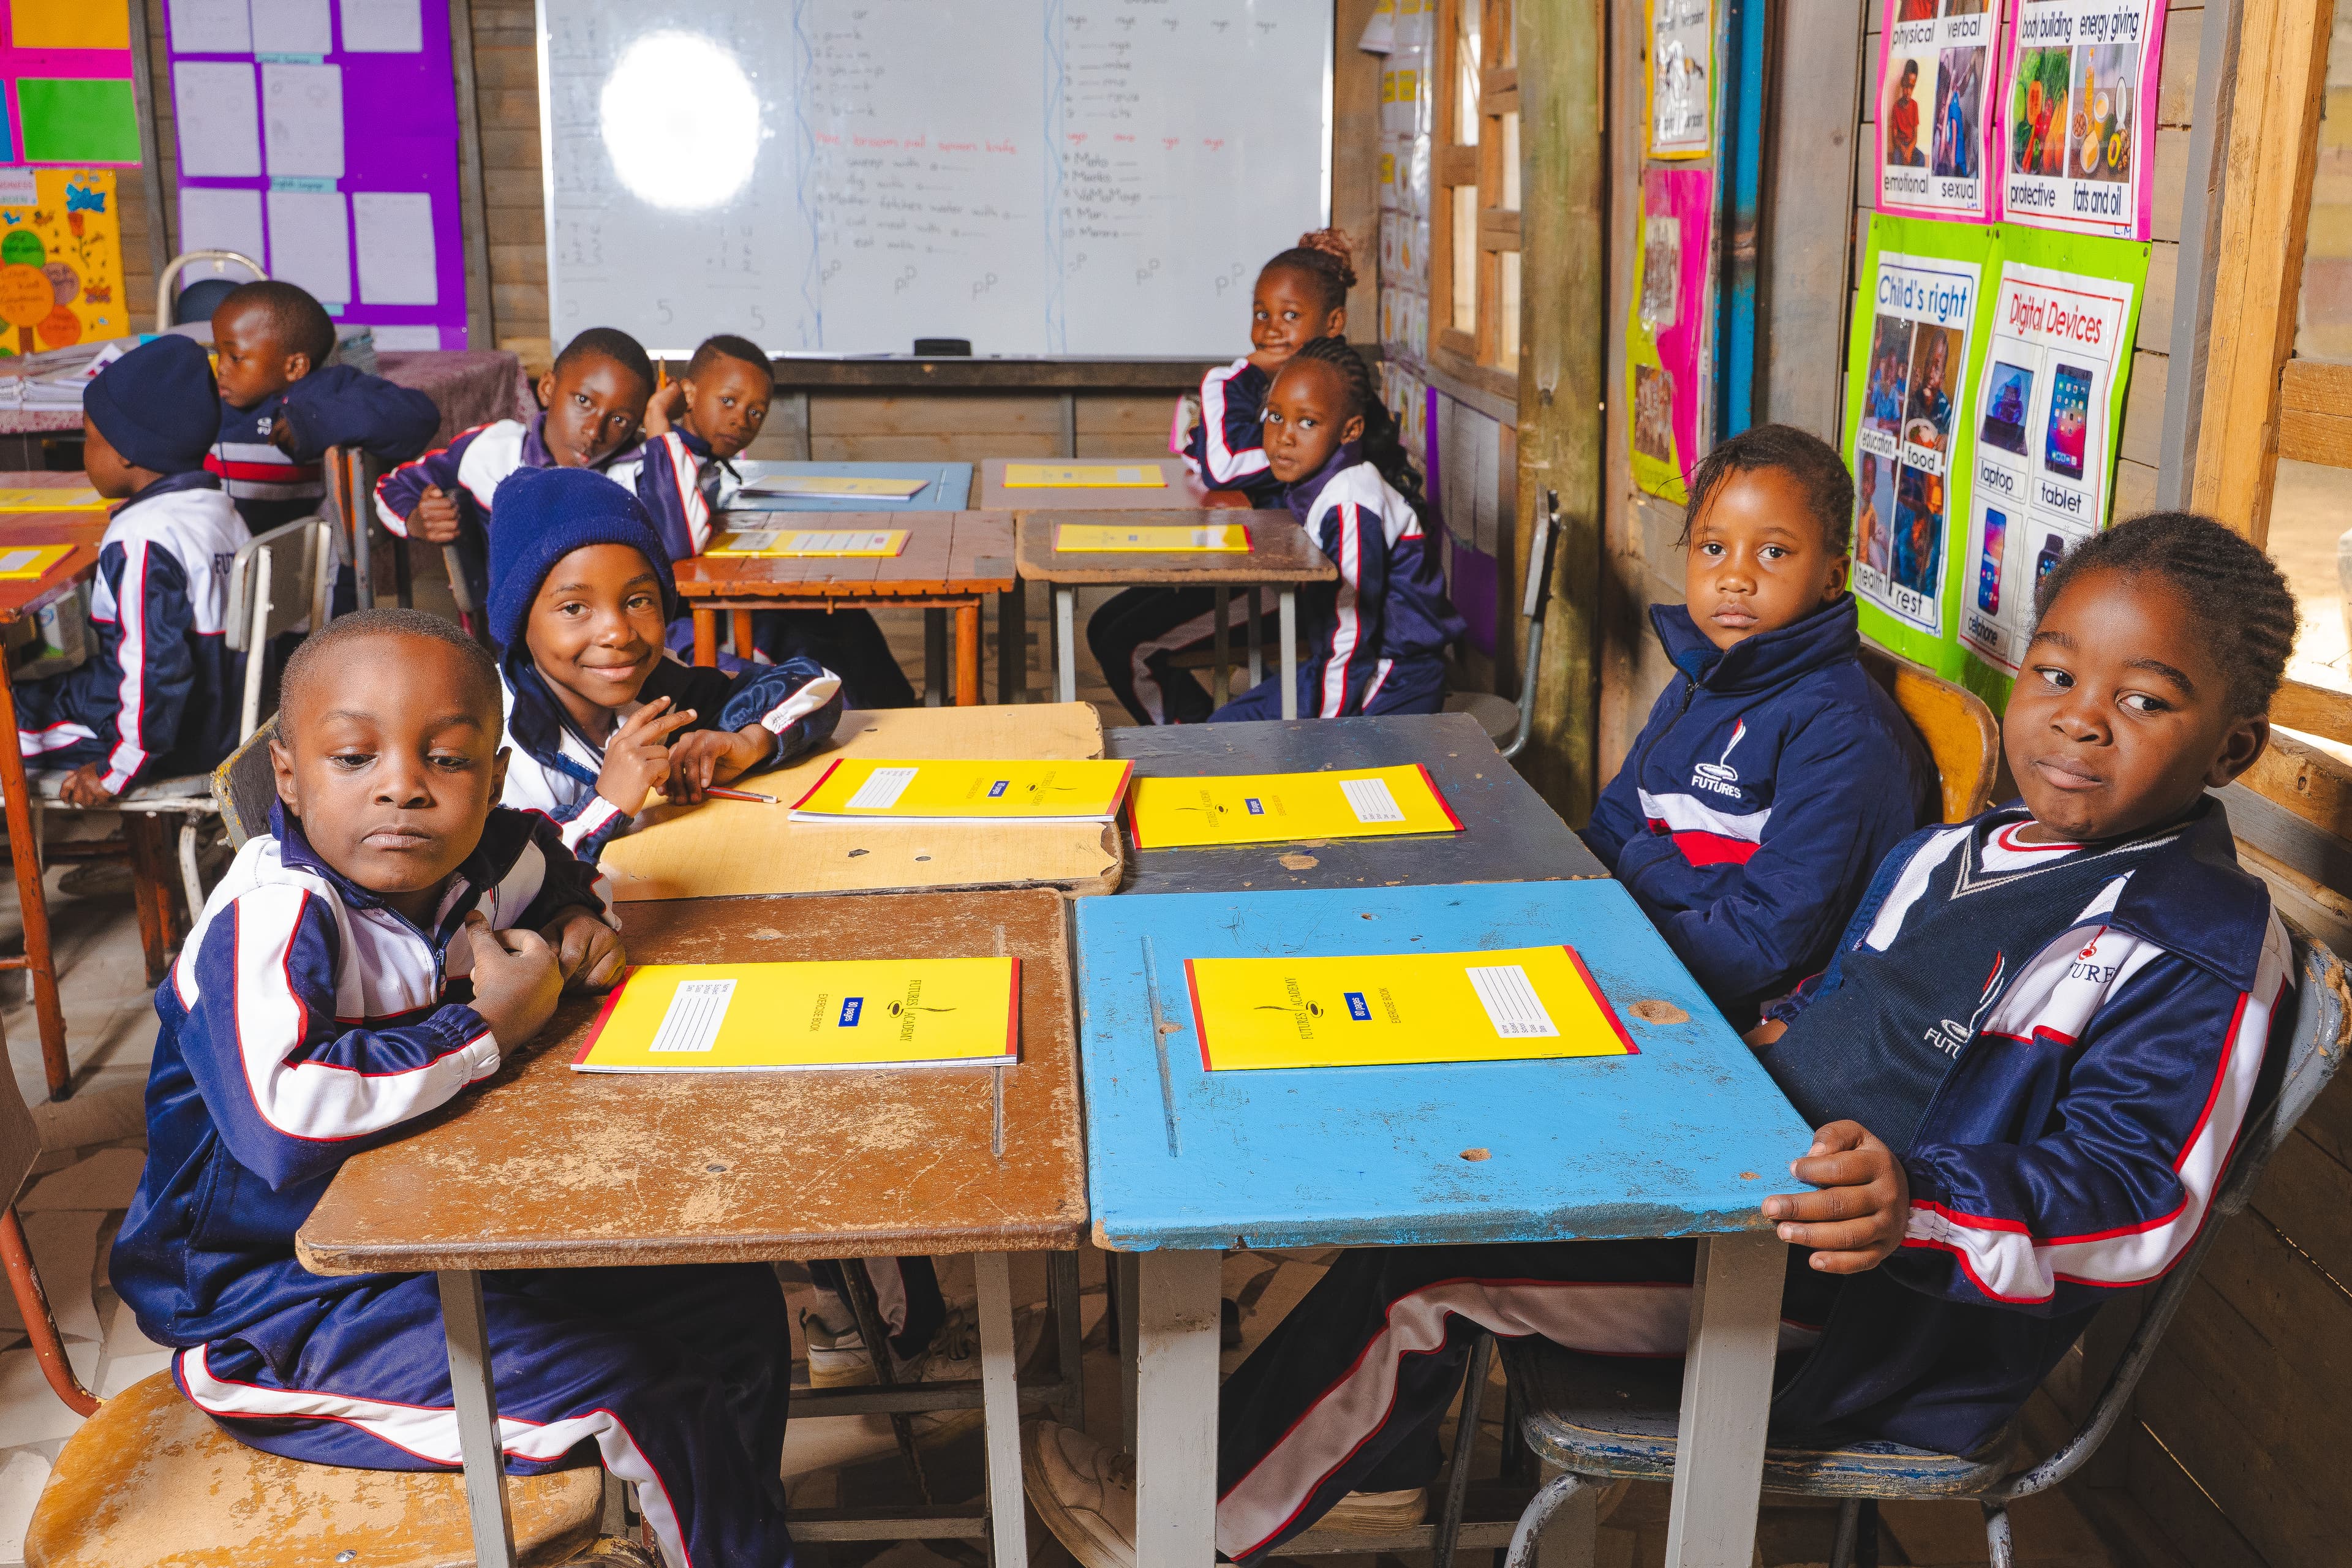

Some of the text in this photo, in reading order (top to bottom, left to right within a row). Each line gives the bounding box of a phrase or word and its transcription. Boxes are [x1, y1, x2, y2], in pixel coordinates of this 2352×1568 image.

[1892, 22, 1935, 50] physical
[1947, 15, 1981, 38] verbal
[2022, 11, 2073, 44] body building
[2080, 5, 2140, 42] energy giving
[1885, 172, 1929, 194] emotional
[1942, 179, 1977, 200] sexual
[2010, 181, 2056, 208] protective
[2073, 181, 2122, 216] fats and oil
[1879, 275, 1967, 322] Child's right
[2009, 293, 2103, 344] Digital Devices
[1861, 431, 1893, 456] education
[1907, 446, 1935, 471] food
[1980, 463, 2014, 494] laptop
[2041, 483, 2082, 514] tablet
[1896, 589, 1922, 616] rest
[1691, 775, 1741, 798] FUTURES
[809, 993, 828, 1032] EXERCISE BOOK
[845, 1008, 855, 1022] pages
[900, 980, 921, 1042] FUTURES ACADEMY
[1284, 977, 1314, 1039] FUTURES ACADEMY
[1352, 997, 1365, 1011] pages
[1378, 987, 1401, 1023] EXERCISE BOOK
